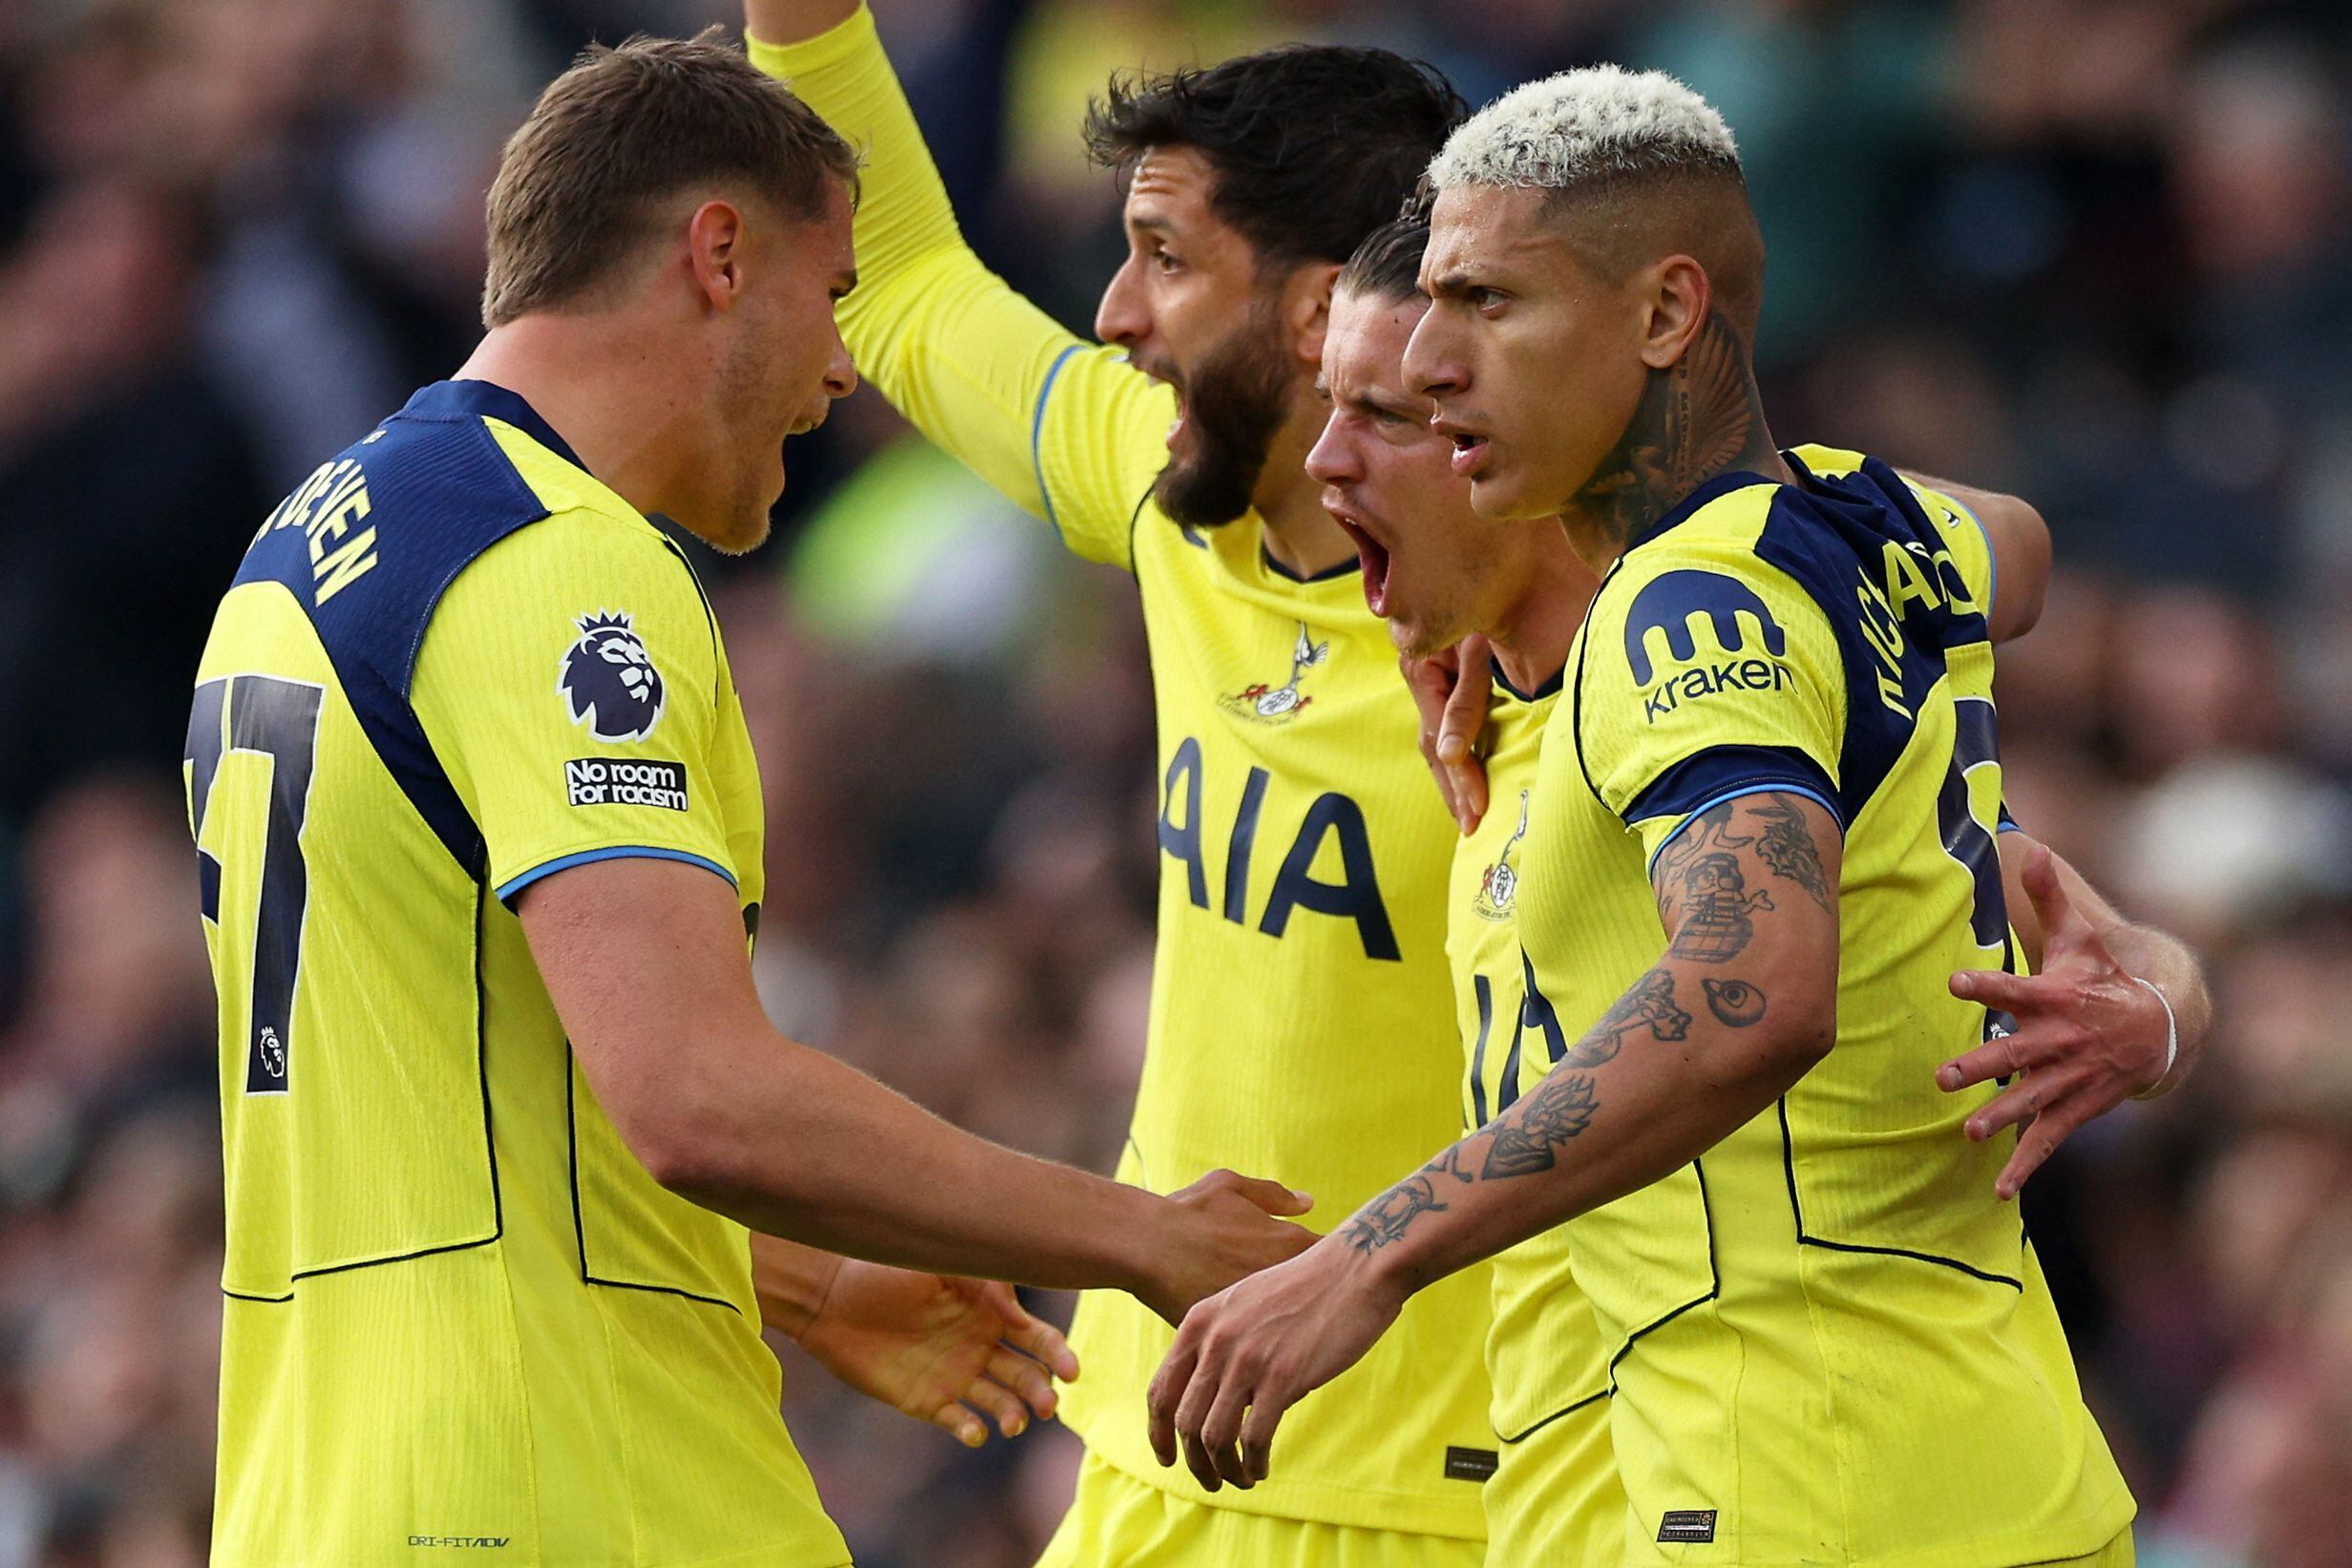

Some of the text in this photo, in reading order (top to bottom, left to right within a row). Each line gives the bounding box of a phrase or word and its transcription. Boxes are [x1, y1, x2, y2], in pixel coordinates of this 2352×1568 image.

[1643, 659, 1800, 725] kraken
[565, 760, 676, 788] No room
[611, 784, 688, 811] racism
[1158, 735, 1404, 964] AIA
